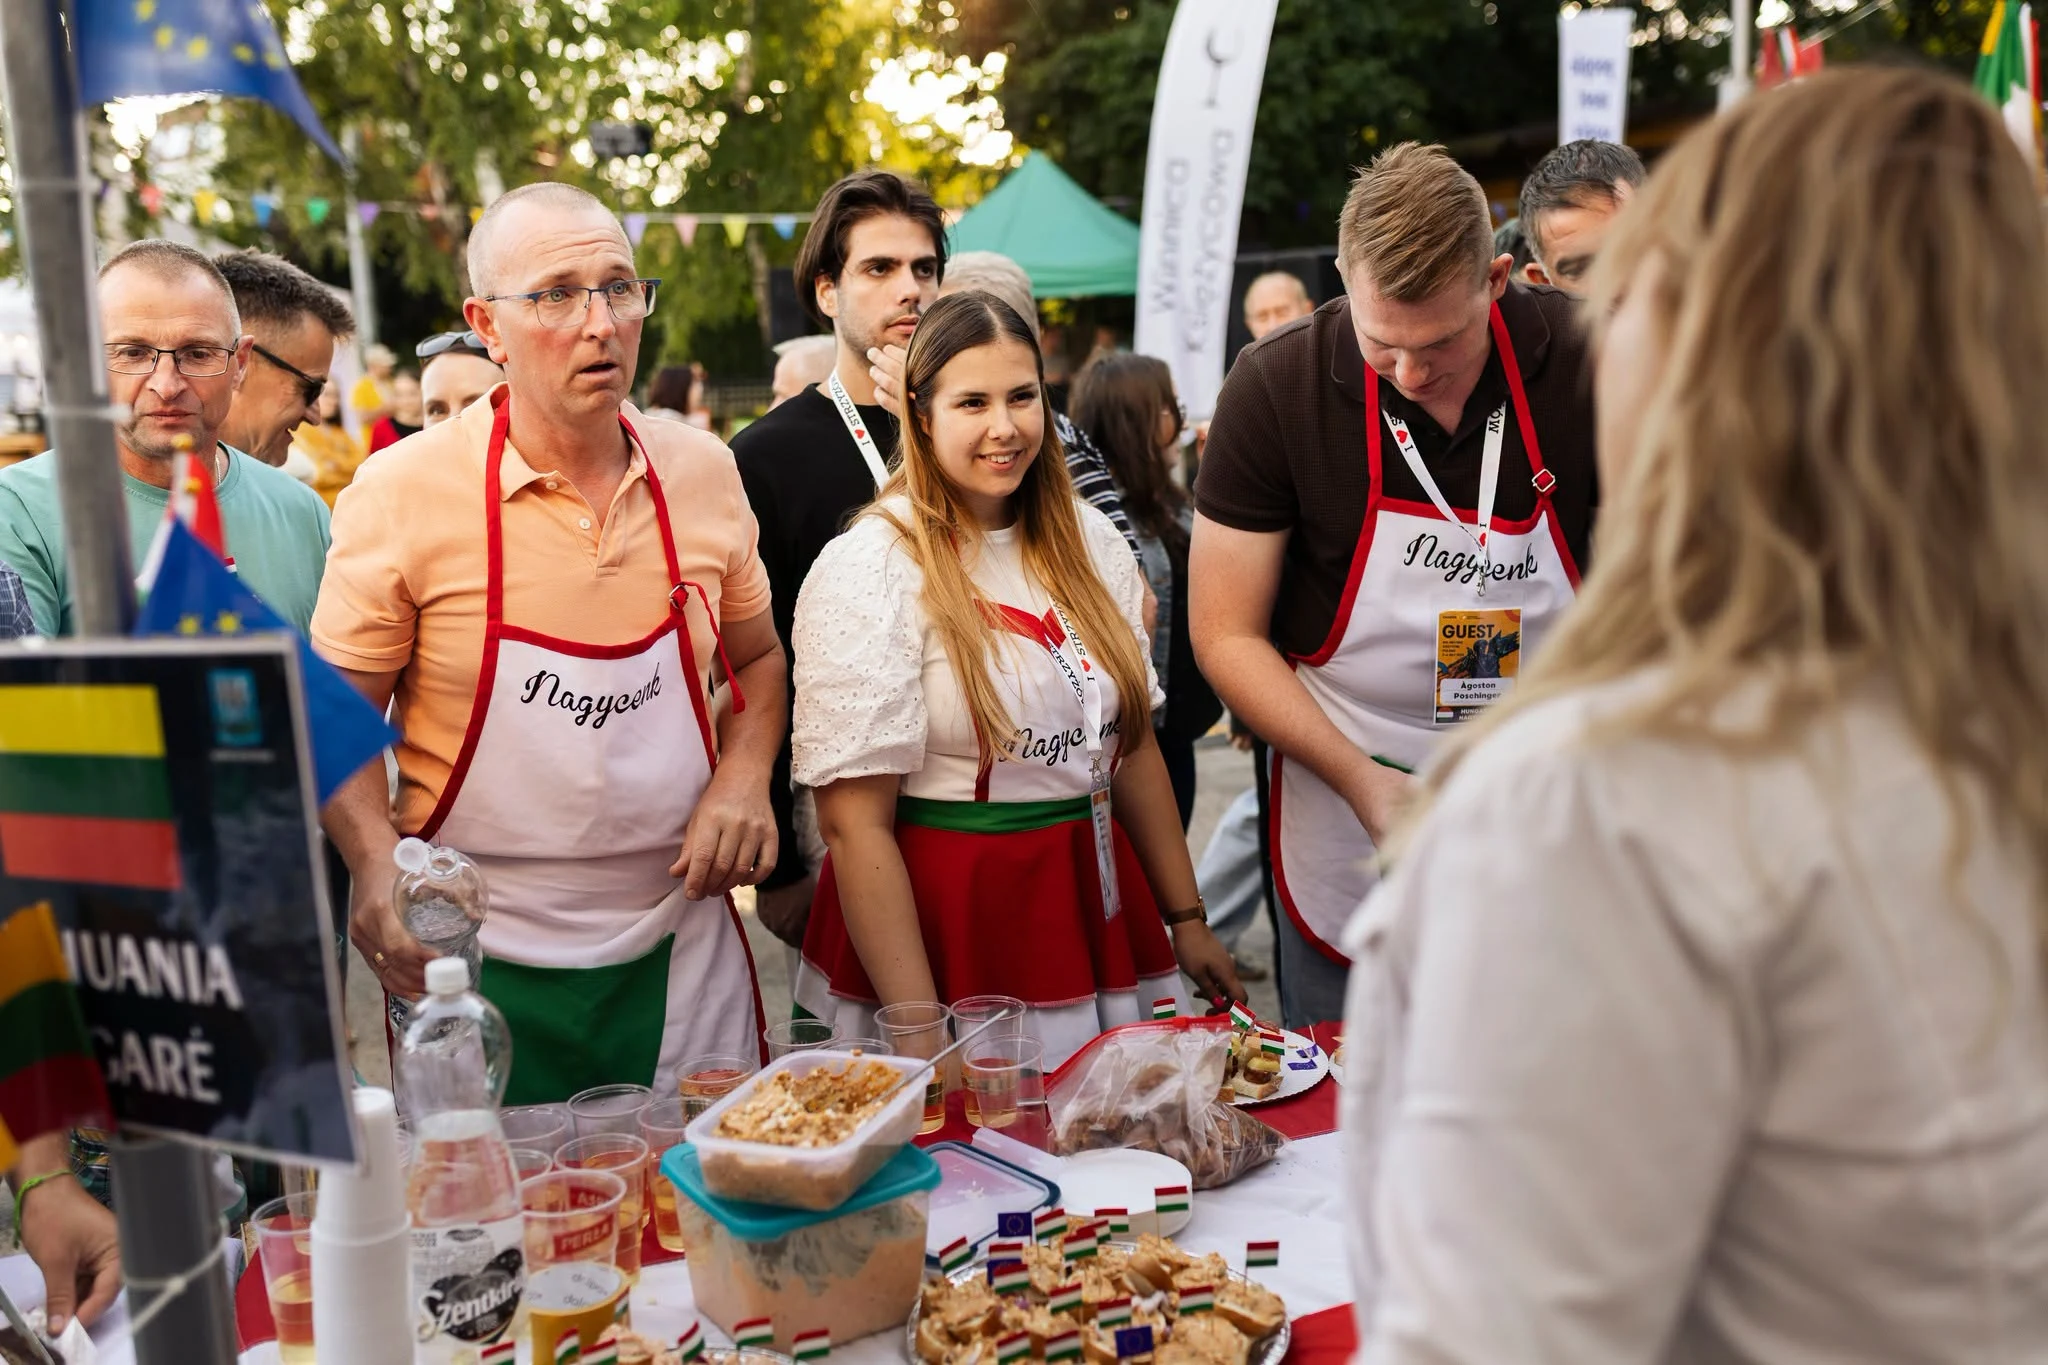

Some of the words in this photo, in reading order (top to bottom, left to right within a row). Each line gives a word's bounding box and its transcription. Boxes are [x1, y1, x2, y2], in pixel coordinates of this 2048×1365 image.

[1442, 624, 1495, 639] GUEST
[521, 662, 663, 730] Nagycenk
[999, 712, 1122, 767] Nagycnk
